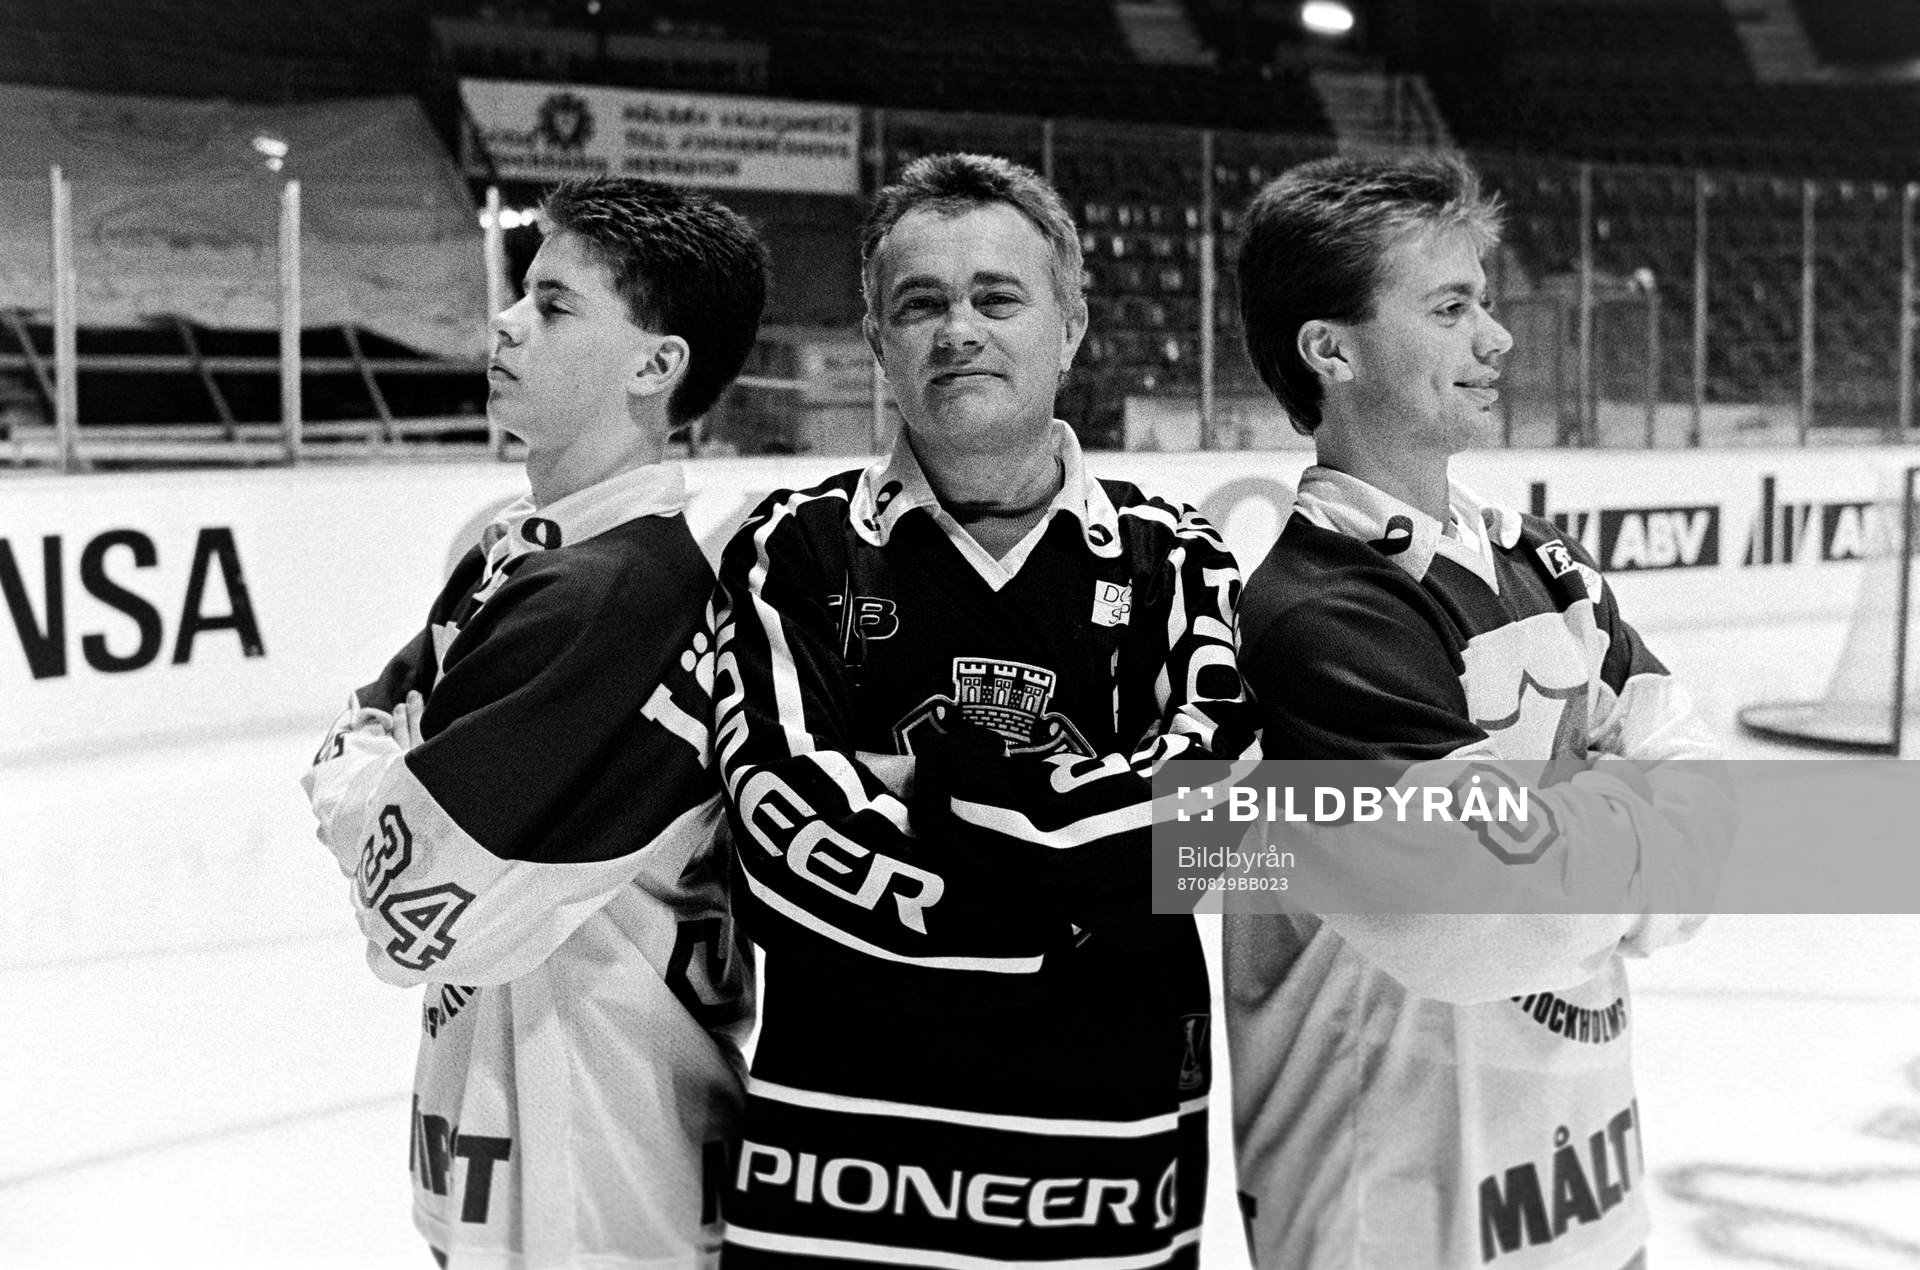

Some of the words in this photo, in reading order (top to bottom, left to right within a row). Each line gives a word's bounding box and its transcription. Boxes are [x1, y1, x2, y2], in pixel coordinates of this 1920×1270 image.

[1611, 508, 1711, 570] ABV
[355, 804, 477, 972] 34
[736, 1138, 1140, 1227] PIONEER
